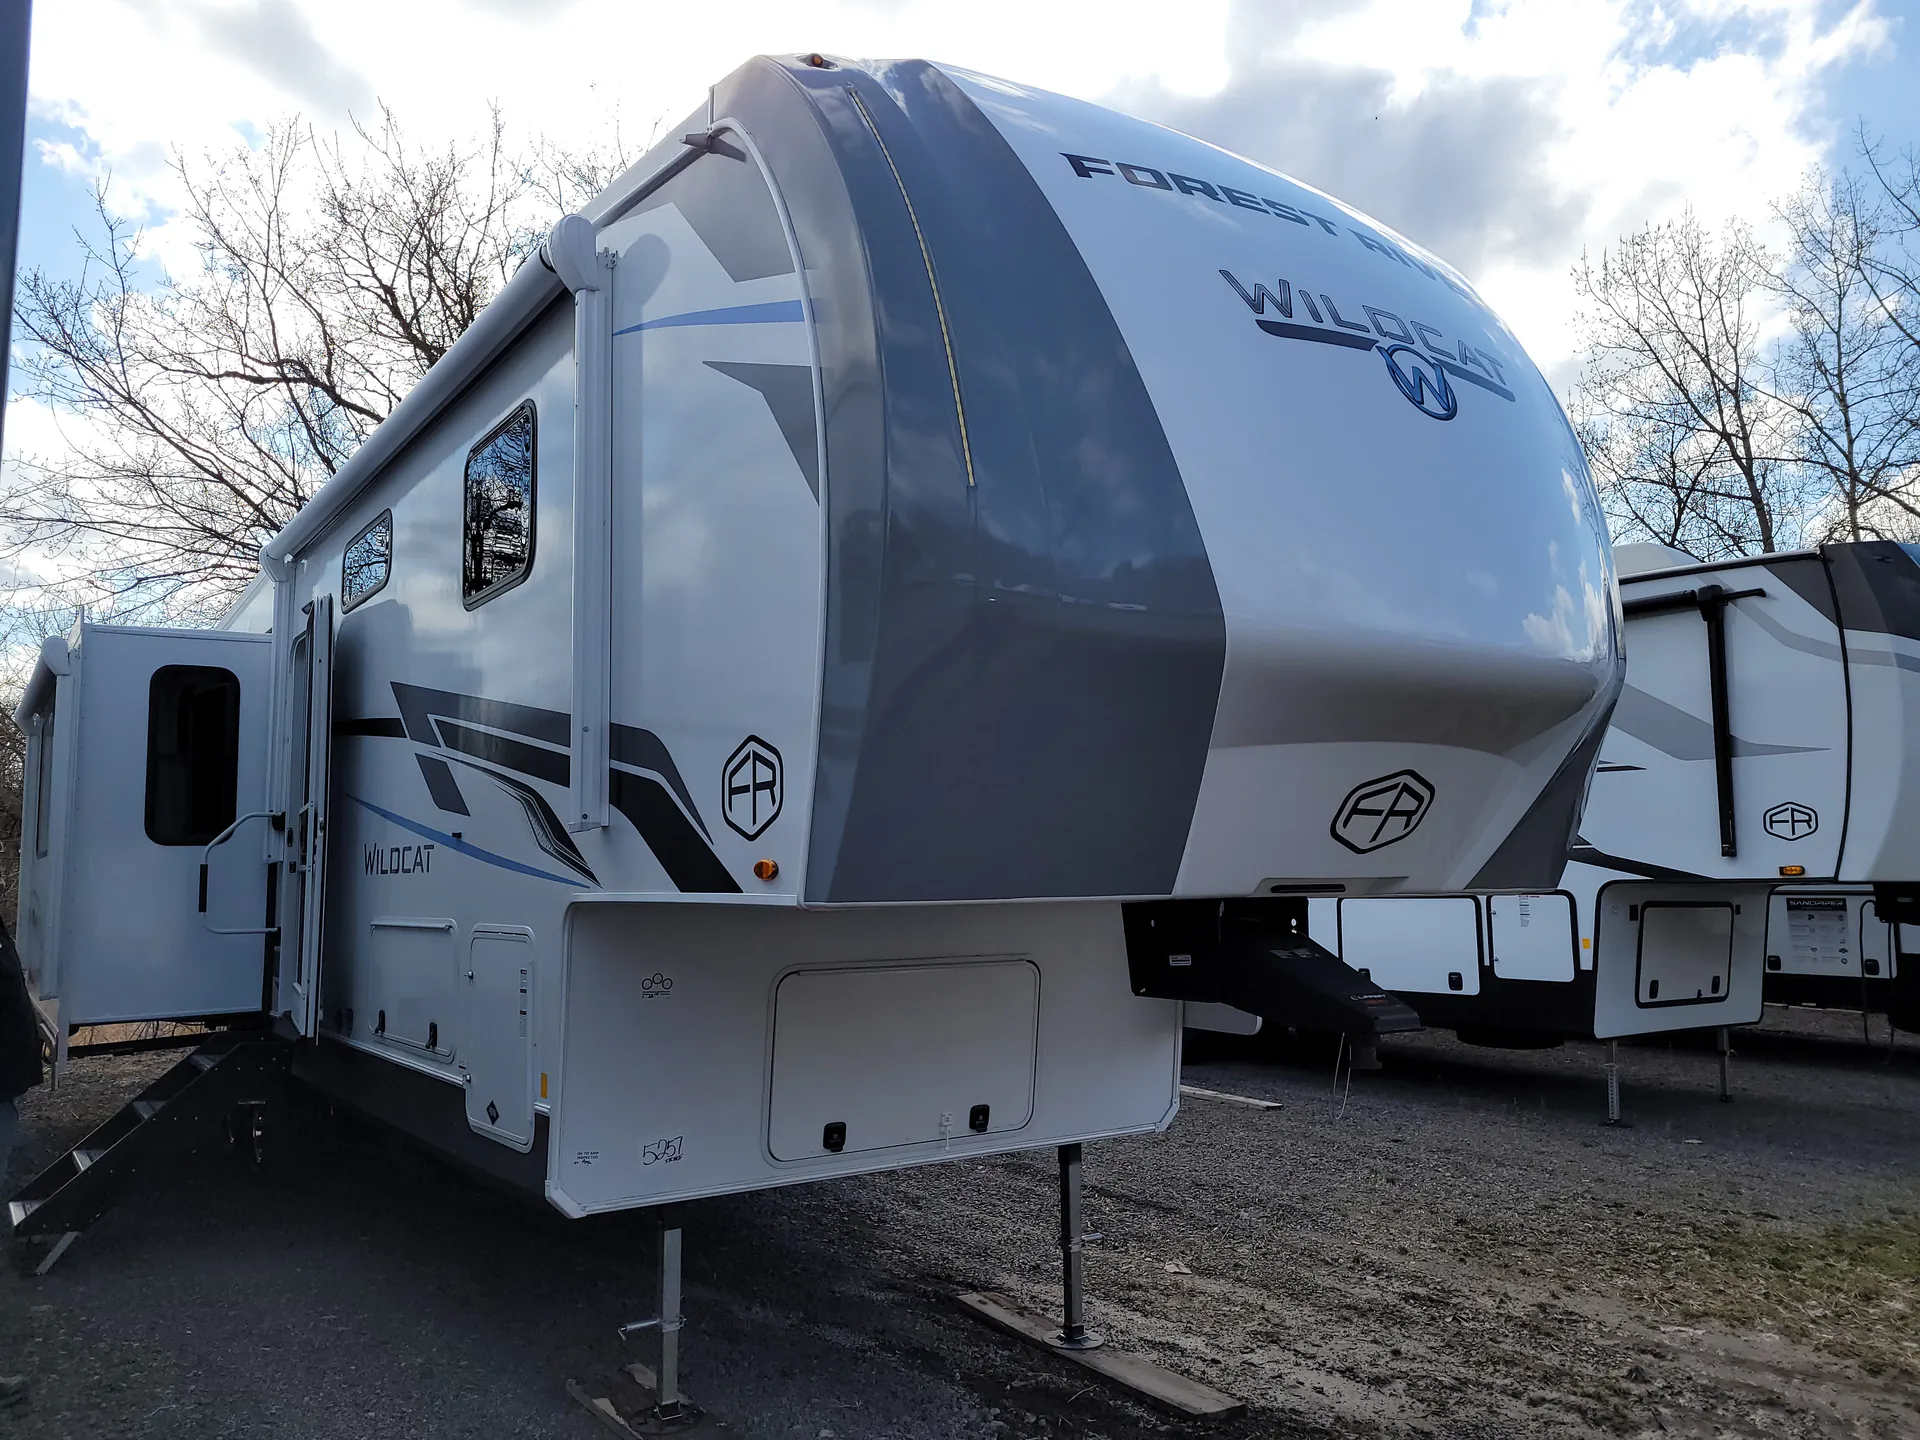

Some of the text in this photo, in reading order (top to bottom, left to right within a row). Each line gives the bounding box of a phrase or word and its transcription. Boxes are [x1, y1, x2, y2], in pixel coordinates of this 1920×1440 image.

[1060, 152, 1338, 236] FOREST
[1219, 269, 1507, 386] WILDCAT
[729, 747, 777, 827] FR
[1342, 781, 1425, 844] FR
[1768, 806, 1813, 836] FR
[364, 843, 435, 876] WILDCAT
[643, 1136, 683, 1165] 5257
